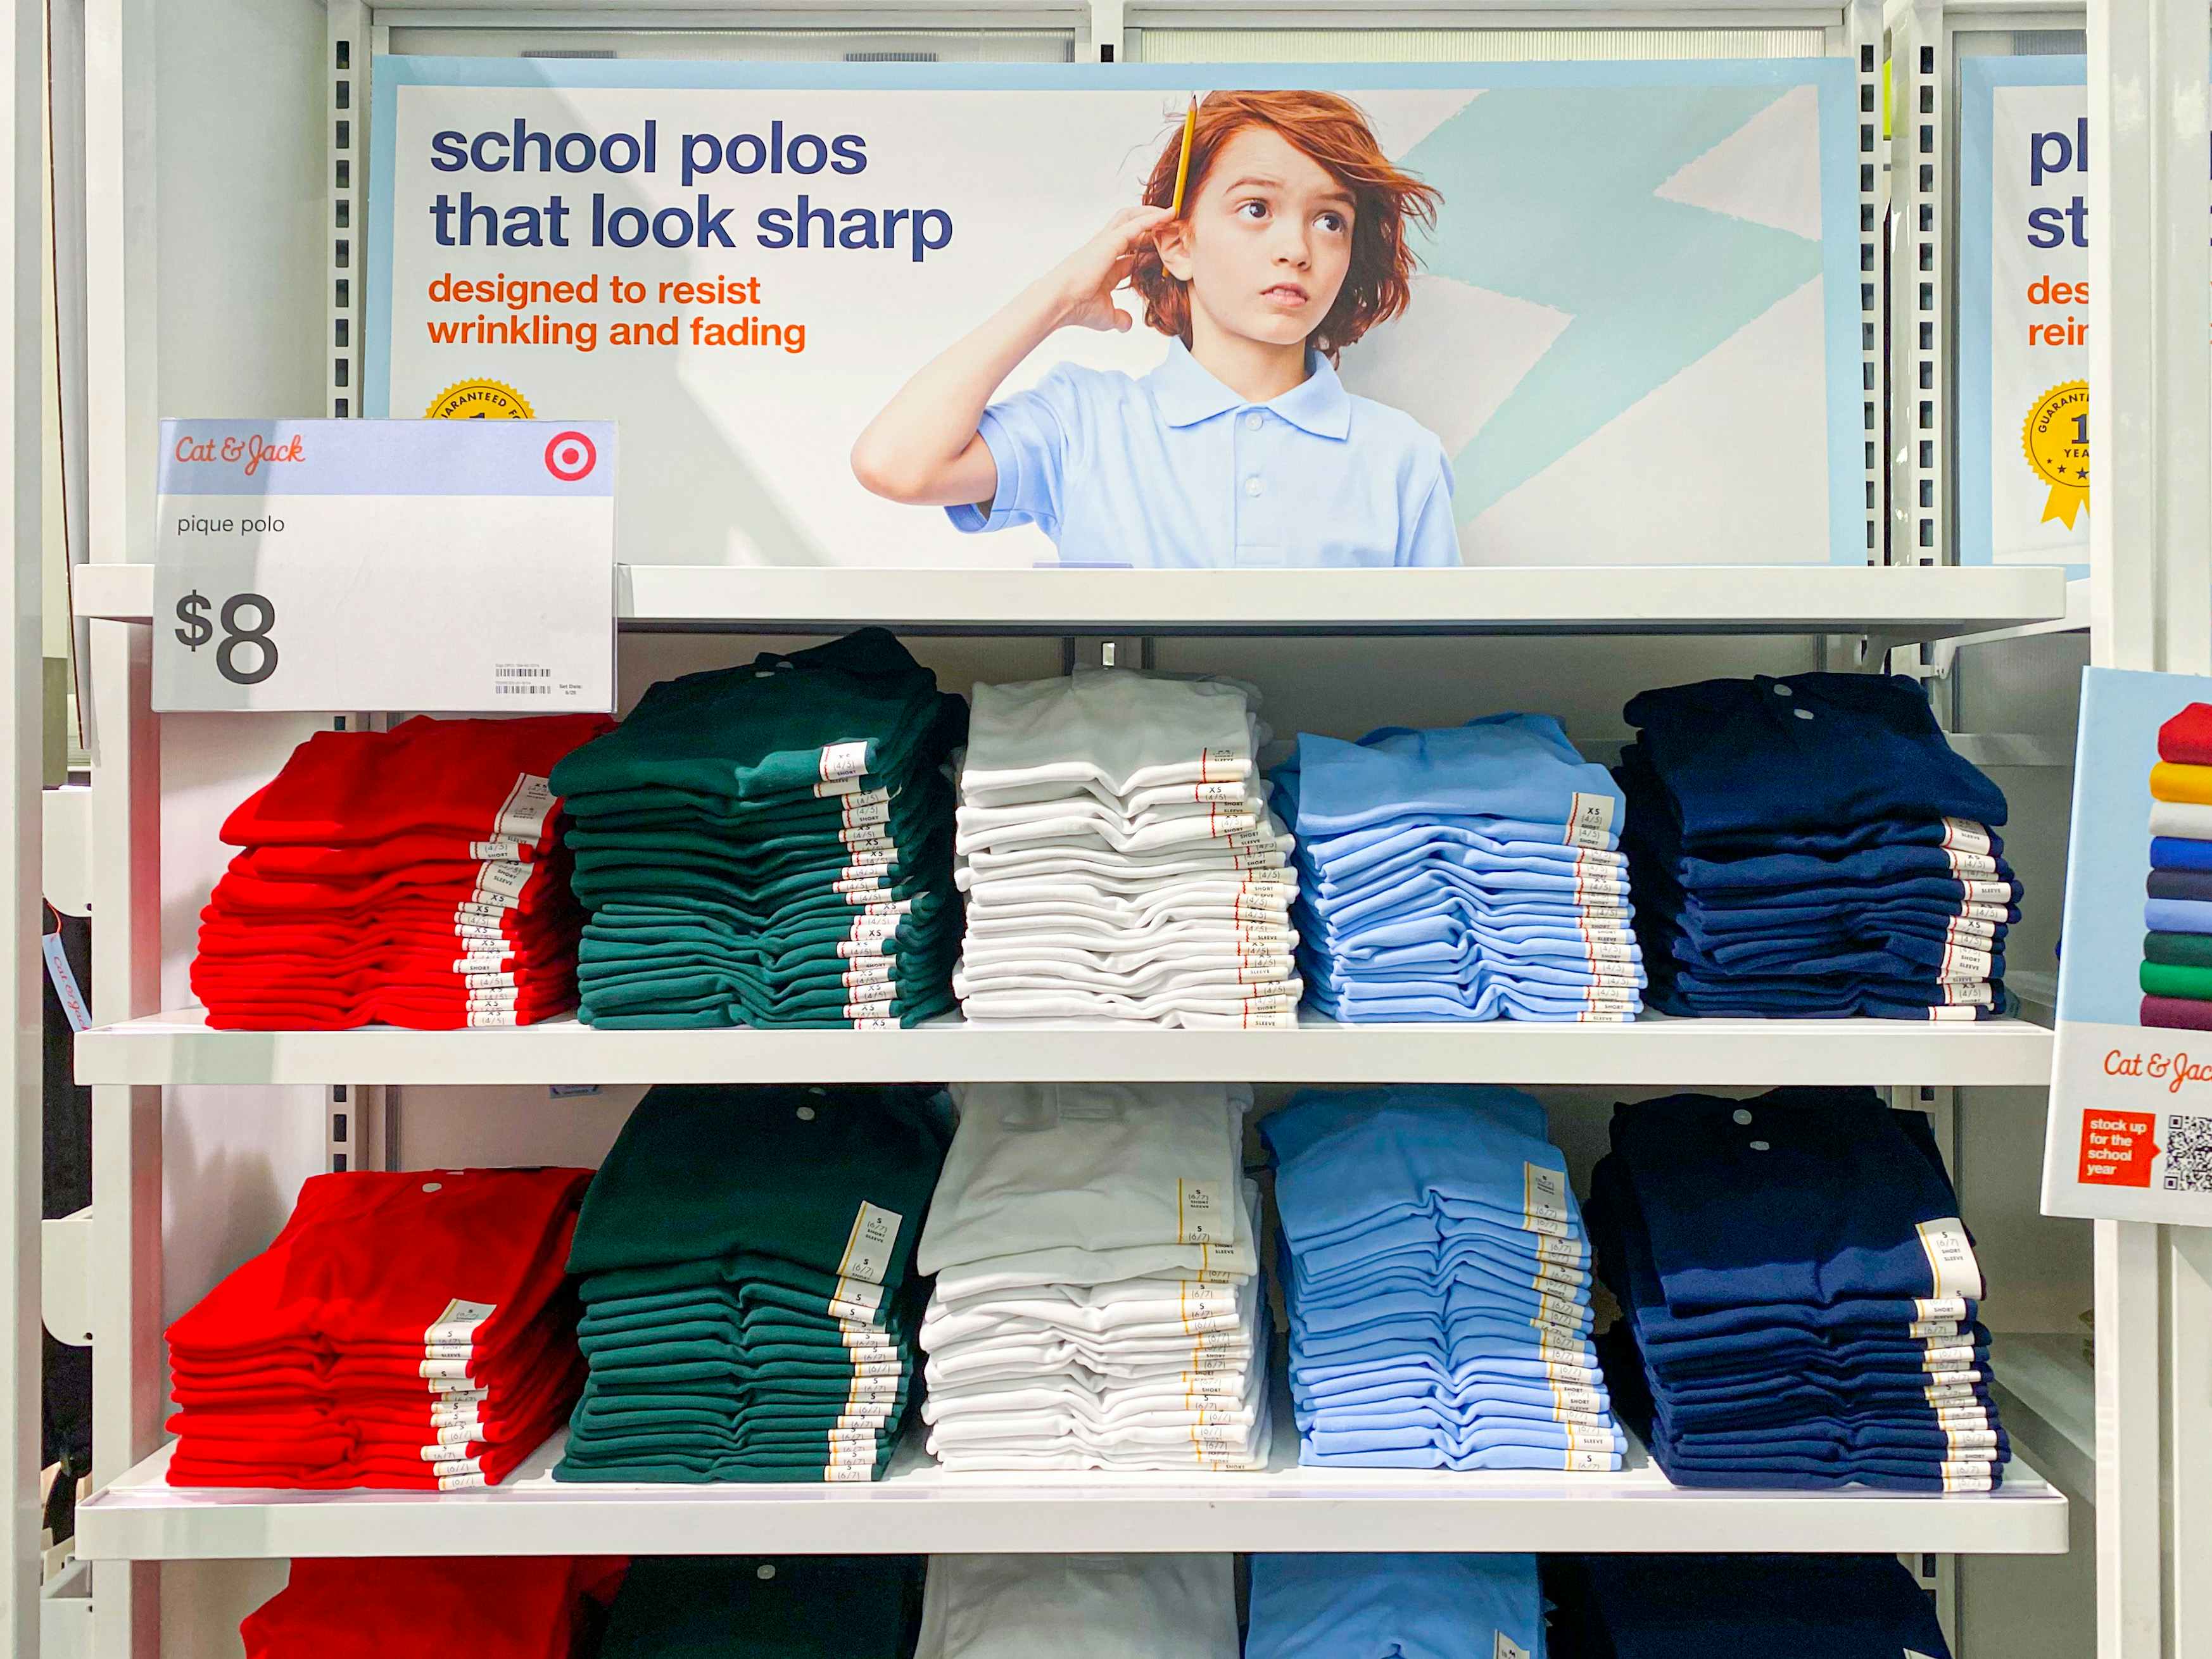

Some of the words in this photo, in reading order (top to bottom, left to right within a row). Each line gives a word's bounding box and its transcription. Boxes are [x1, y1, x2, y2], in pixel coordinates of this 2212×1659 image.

[431, 118, 656, 173] school
[681, 120, 868, 186] polos
[2030, 118, 2088, 186] pl
[429, 192, 569, 248] that
[591, 193, 736, 248] look
[756, 194, 954, 262] sharp
[2027, 196, 2088, 248] st
[428, 274, 598, 309] designed
[611, 277, 647, 304] to
[658, 276, 761, 306] resist
[2027, 276, 2089, 305] des
[427, 317, 598, 351] wrinkling
[610, 317, 679, 346] and
[690, 317, 806, 353] fading
[441, 391, 507, 418] ARANTEED
[2038, 393, 2089, 432] GUARANT
[2071, 413, 2089, 444] 1
[175, 436, 216, 463] Cat
[220, 438, 246, 462] &
[244, 433, 306, 476] Jack
[2064, 449, 2089, 457] YEA
[177, 515, 234, 535] pique
[241, 515, 285, 535] polo
[174, 589, 279, 685] $8
[833, 760, 854, 770] (4/5)
[857, 794, 879, 805] (4/5)
[856, 805, 878, 815] (4/5)
[494, 876, 513, 886] SLEEVE
[498, 869, 517, 879] SHORT
[1259, 871, 1280, 879] (4/5)
[491, 893, 504, 902] XS
[861, 893, 881, 902] (4/5)
[480, 978, 503, 987] (4/5)
[864, 991, 886, 999] (4/5)
[2104, 1049, 2142, 1076] Cat
[2148, 1053, 2170, 1078] &
[2169, 1052, 2212, 1093] Jac
[2090, 1119, 2127, 1130] stock
[2130, 1123, 2146, 1135] up
[2090, 1133, 2108, 1145] for
[2111, 1134, 2132, 1146] the
[2088, 1149, 2132, 1161] school
[2087, 1163, 2117, 1175] year
[852, 1263, 875, 1277] (6/7)
[838, 1471, 859, 1479] (6/7)
